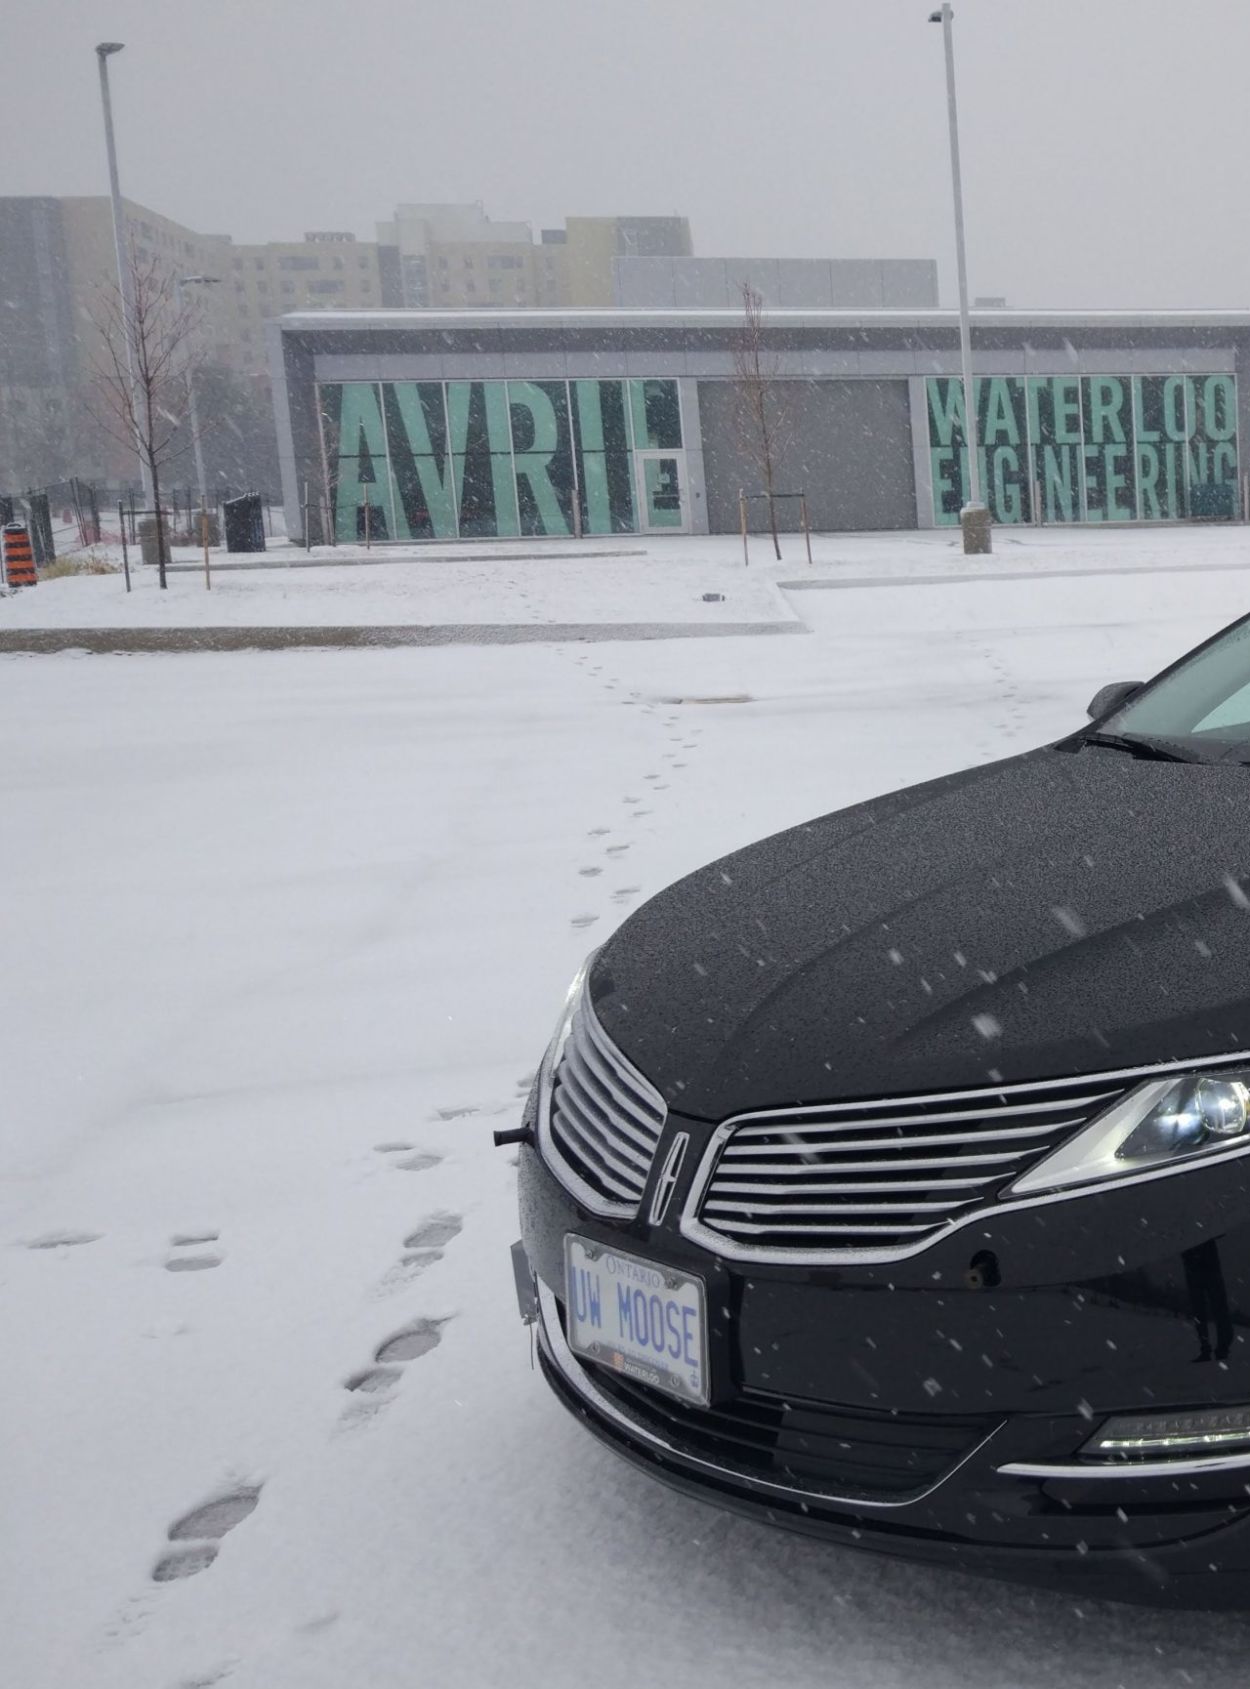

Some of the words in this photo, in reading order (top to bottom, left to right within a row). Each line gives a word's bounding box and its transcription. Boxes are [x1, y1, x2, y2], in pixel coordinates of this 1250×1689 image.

[925, 375, 1237, 445] WATERLOO
[606, 1255, 661, 1288] ONTARIO
[571, 1265, 602, 1329] UW
[616, 1282, 699, 1368] MOOSE
